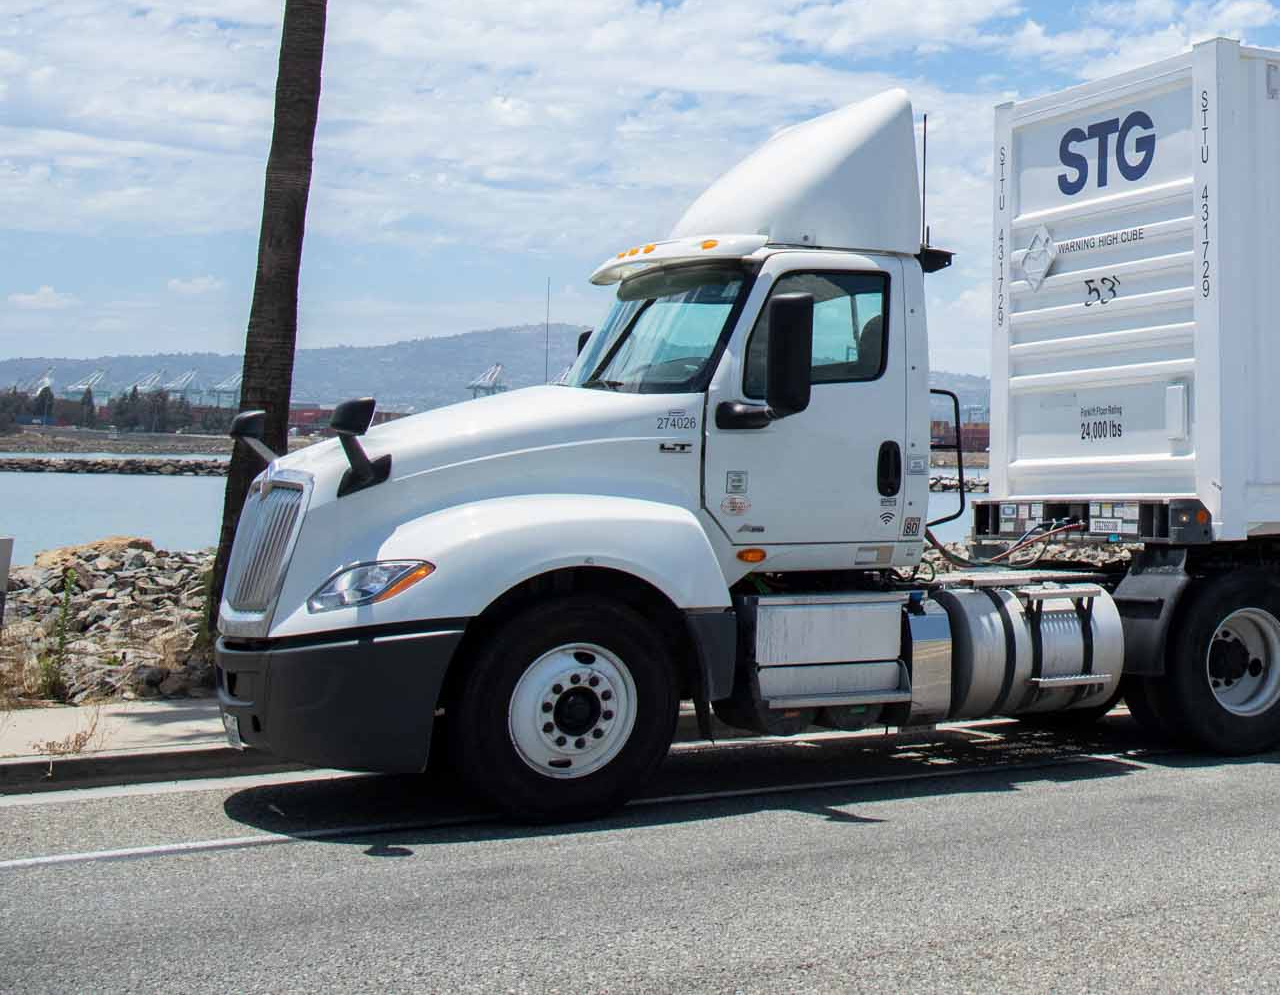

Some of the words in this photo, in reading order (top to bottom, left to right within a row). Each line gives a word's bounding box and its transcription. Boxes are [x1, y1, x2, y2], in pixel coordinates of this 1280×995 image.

[1057, 110, 1156, 196] STG
[1200, 90, 1209, 165] STTU
[1057, 237, 1096, 254] WARNING
[1098, 232, 1119, 247] HIGH
[1120, 228, 1145, 244] CUBE
[1201, 184, 1211, 298] 431729
[1080, 420, 1108, 443] 24,000
[1109, 420, 1122, 438] lbs
